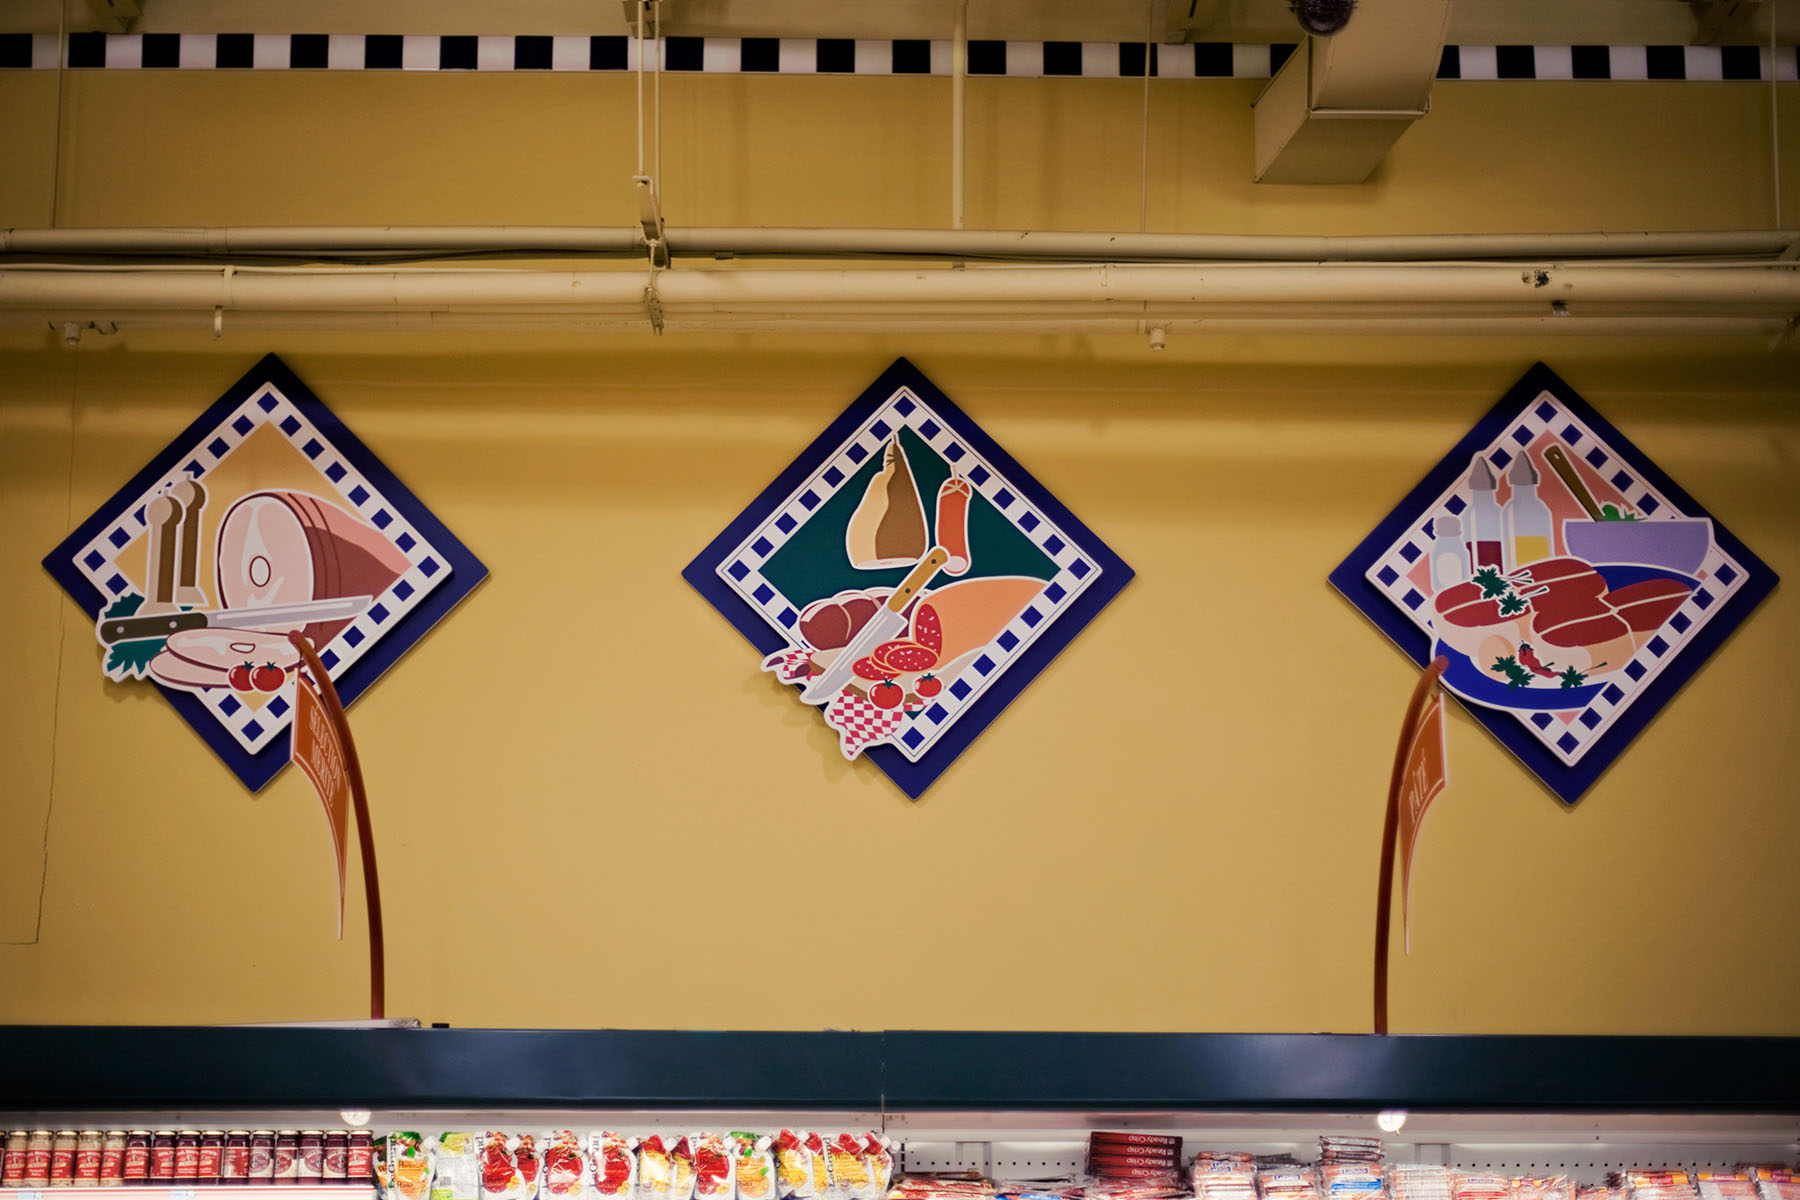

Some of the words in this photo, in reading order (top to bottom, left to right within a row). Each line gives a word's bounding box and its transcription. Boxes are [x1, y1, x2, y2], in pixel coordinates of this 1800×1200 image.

[1128, 1135, 1146, 1143] Crisp
[1146, 1135, 1168, 1145] Ready
[1126, 1146, 1145, 1154] Crisp
[1145, 1146, 1167, 1156] Ready
[1126, 1157, 1145, 1165] Crisp
[1145, 1157, 1167, 1167] Ready
[1131, 1169, 1150, 1177] Crisp
